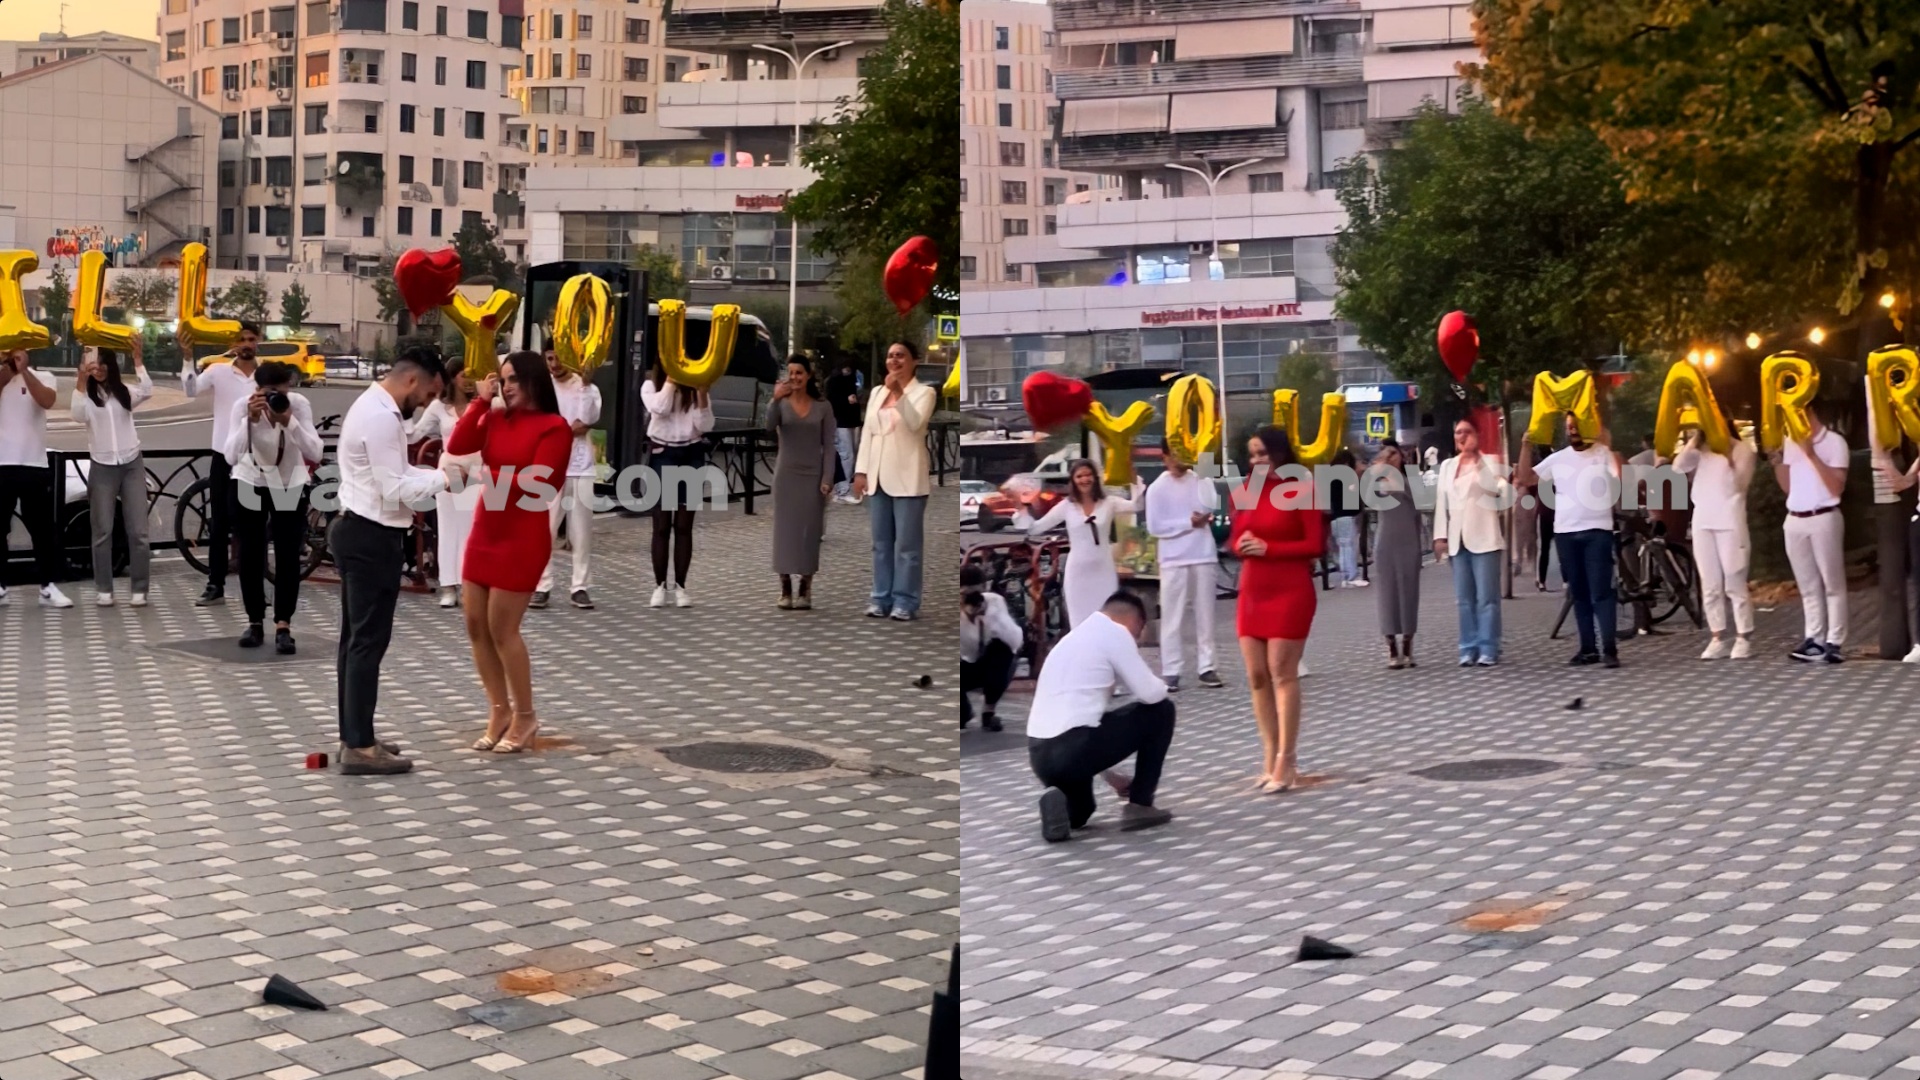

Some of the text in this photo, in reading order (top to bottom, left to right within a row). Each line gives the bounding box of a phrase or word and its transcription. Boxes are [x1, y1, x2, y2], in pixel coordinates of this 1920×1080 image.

[441, 272, 741, 388] YOU
[1276, 303, 1302, 317] ATC
[1083, 374, 1347, 486] YOU
